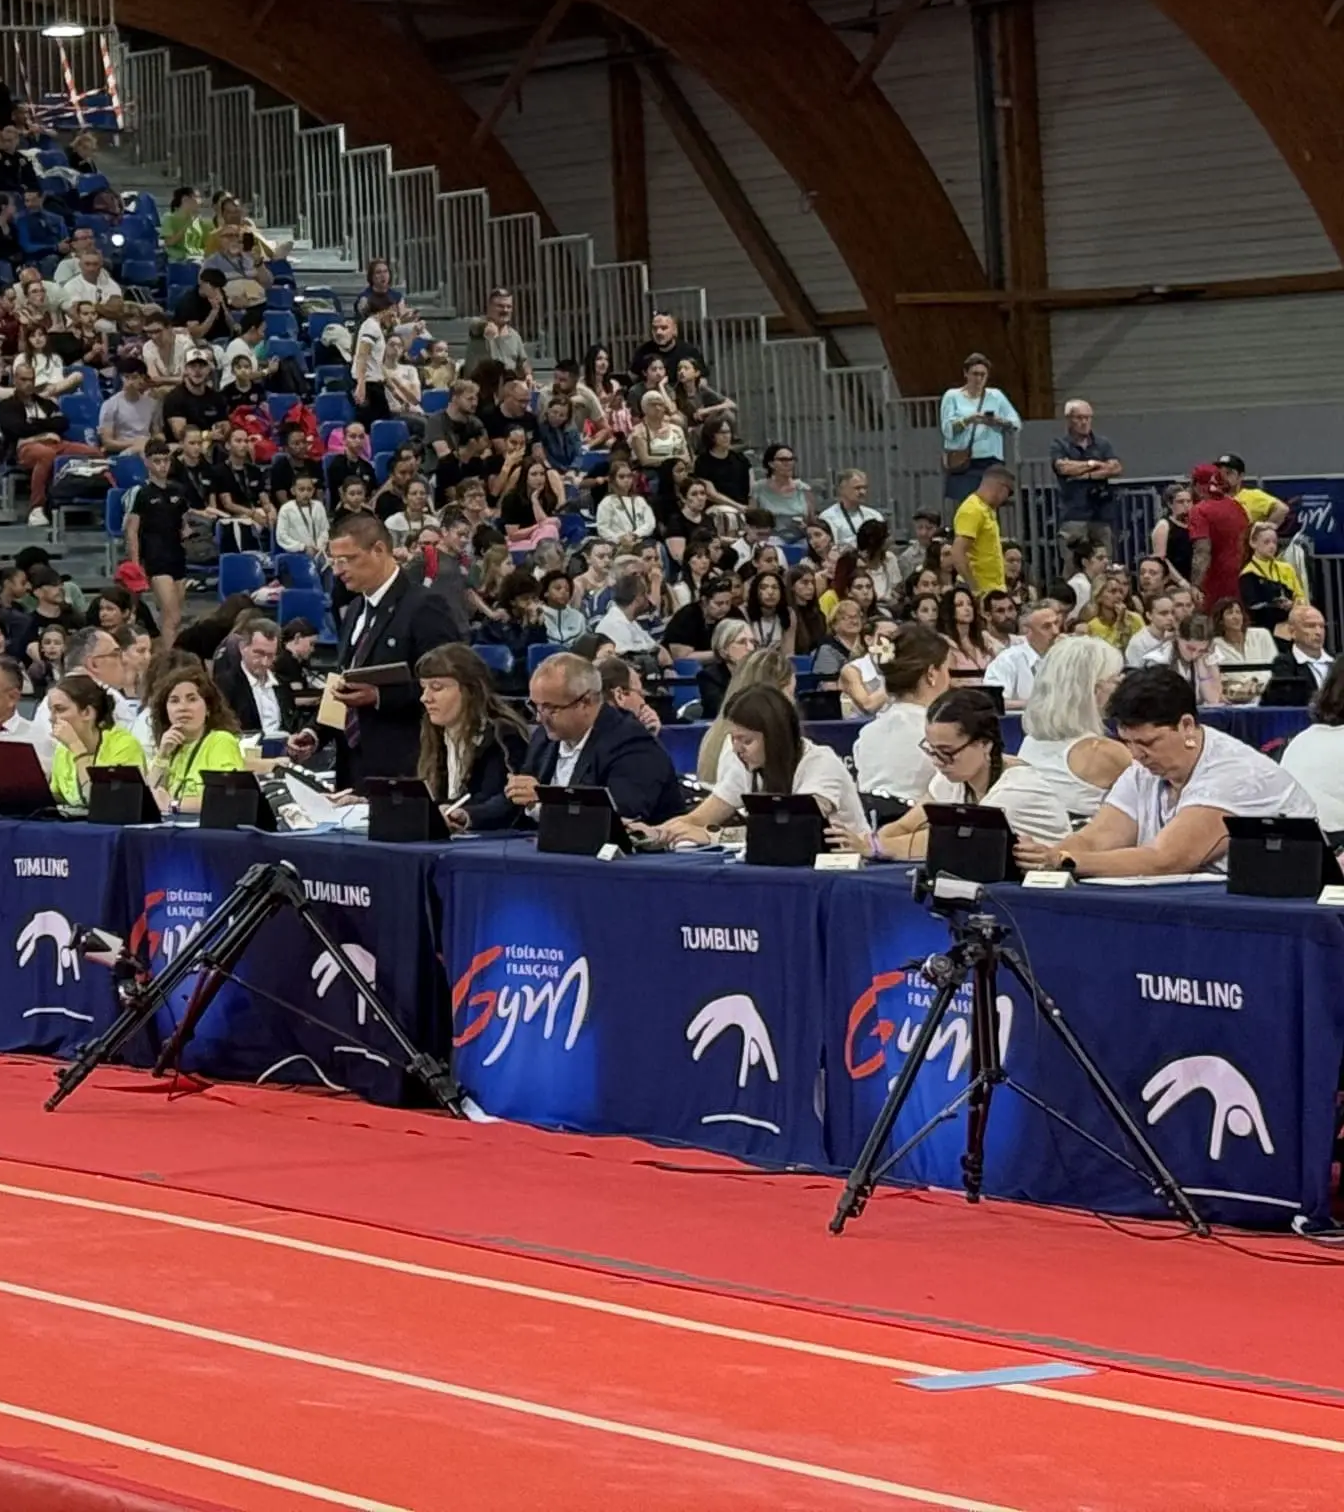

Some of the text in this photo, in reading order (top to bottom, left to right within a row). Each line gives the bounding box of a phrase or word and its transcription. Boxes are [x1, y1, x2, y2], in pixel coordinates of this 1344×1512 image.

[14, 857, 69, 877] TUMBLING
[302, 879, 371, 907] TUMBLING
[681, 926, 759, 952] TUMBLING
[1136, 973, 1244, 1010] TUMBLING
[452, 945, 590, 1067] Gym
